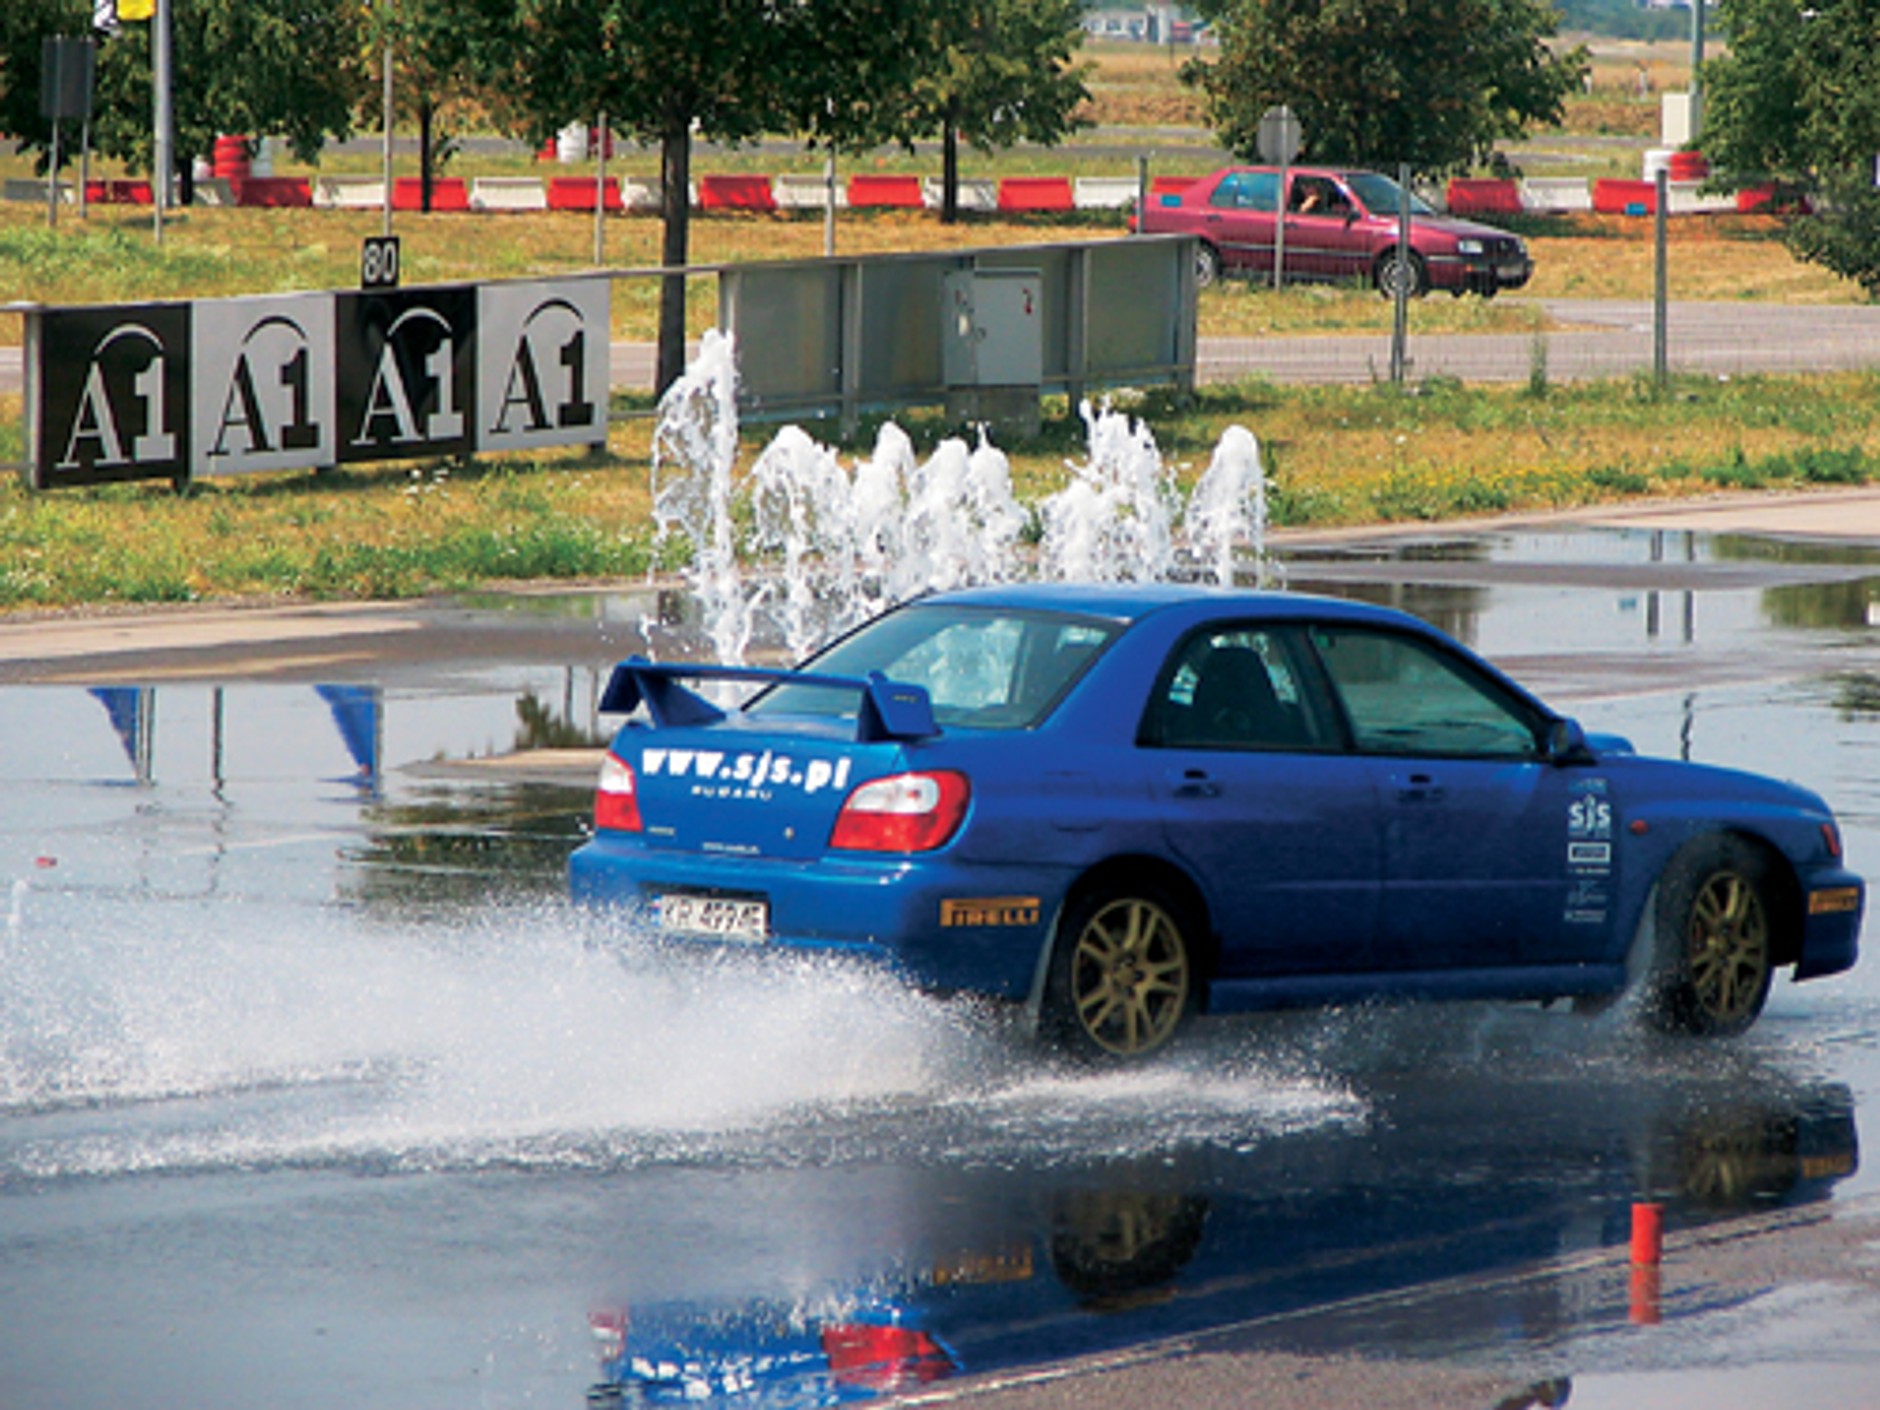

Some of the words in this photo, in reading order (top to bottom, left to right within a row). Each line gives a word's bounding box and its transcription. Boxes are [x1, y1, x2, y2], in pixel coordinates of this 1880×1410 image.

[364, 241, 396, 282] 80
[55, 355, 177, 468] A1
[207, 346, 320, 456] A1
[350, 338, 464, 445] A1
[489, 330, 595, 433] A1
[642, 748, 851, 794] www.sjs.pl
